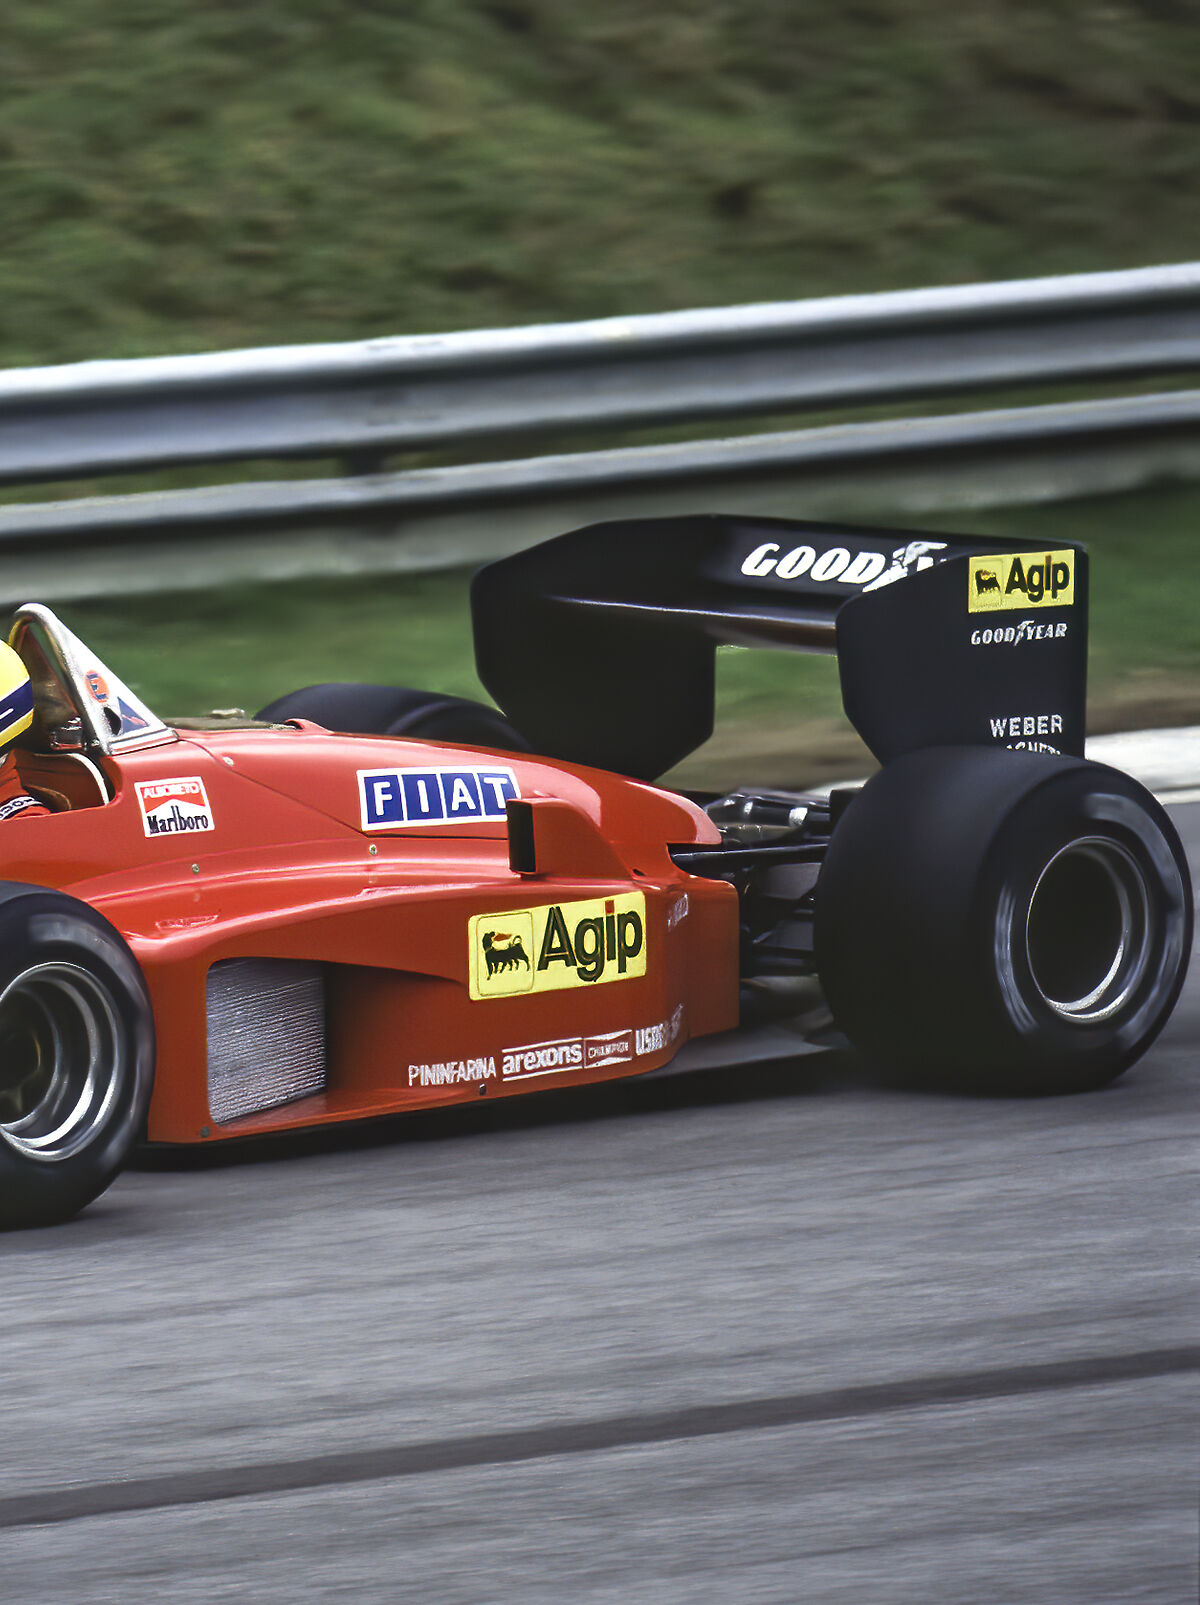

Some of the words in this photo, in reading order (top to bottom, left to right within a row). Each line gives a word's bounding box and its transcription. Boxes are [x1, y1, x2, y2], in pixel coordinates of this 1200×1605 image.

[1005, 555, 1070, 603] Agip
[970, 620, 1068, 646] GOODYEAR
[990, 714, 1063, 738] WEBER
[373, 776, 509, 817] FIAT
[146, 805, 209, 834] Marlboro
[537, 900, 643, 983] Agip
[408, 1056, 497, 1087] PININFARINA
[502, 1043, 583, 1075] arexons
